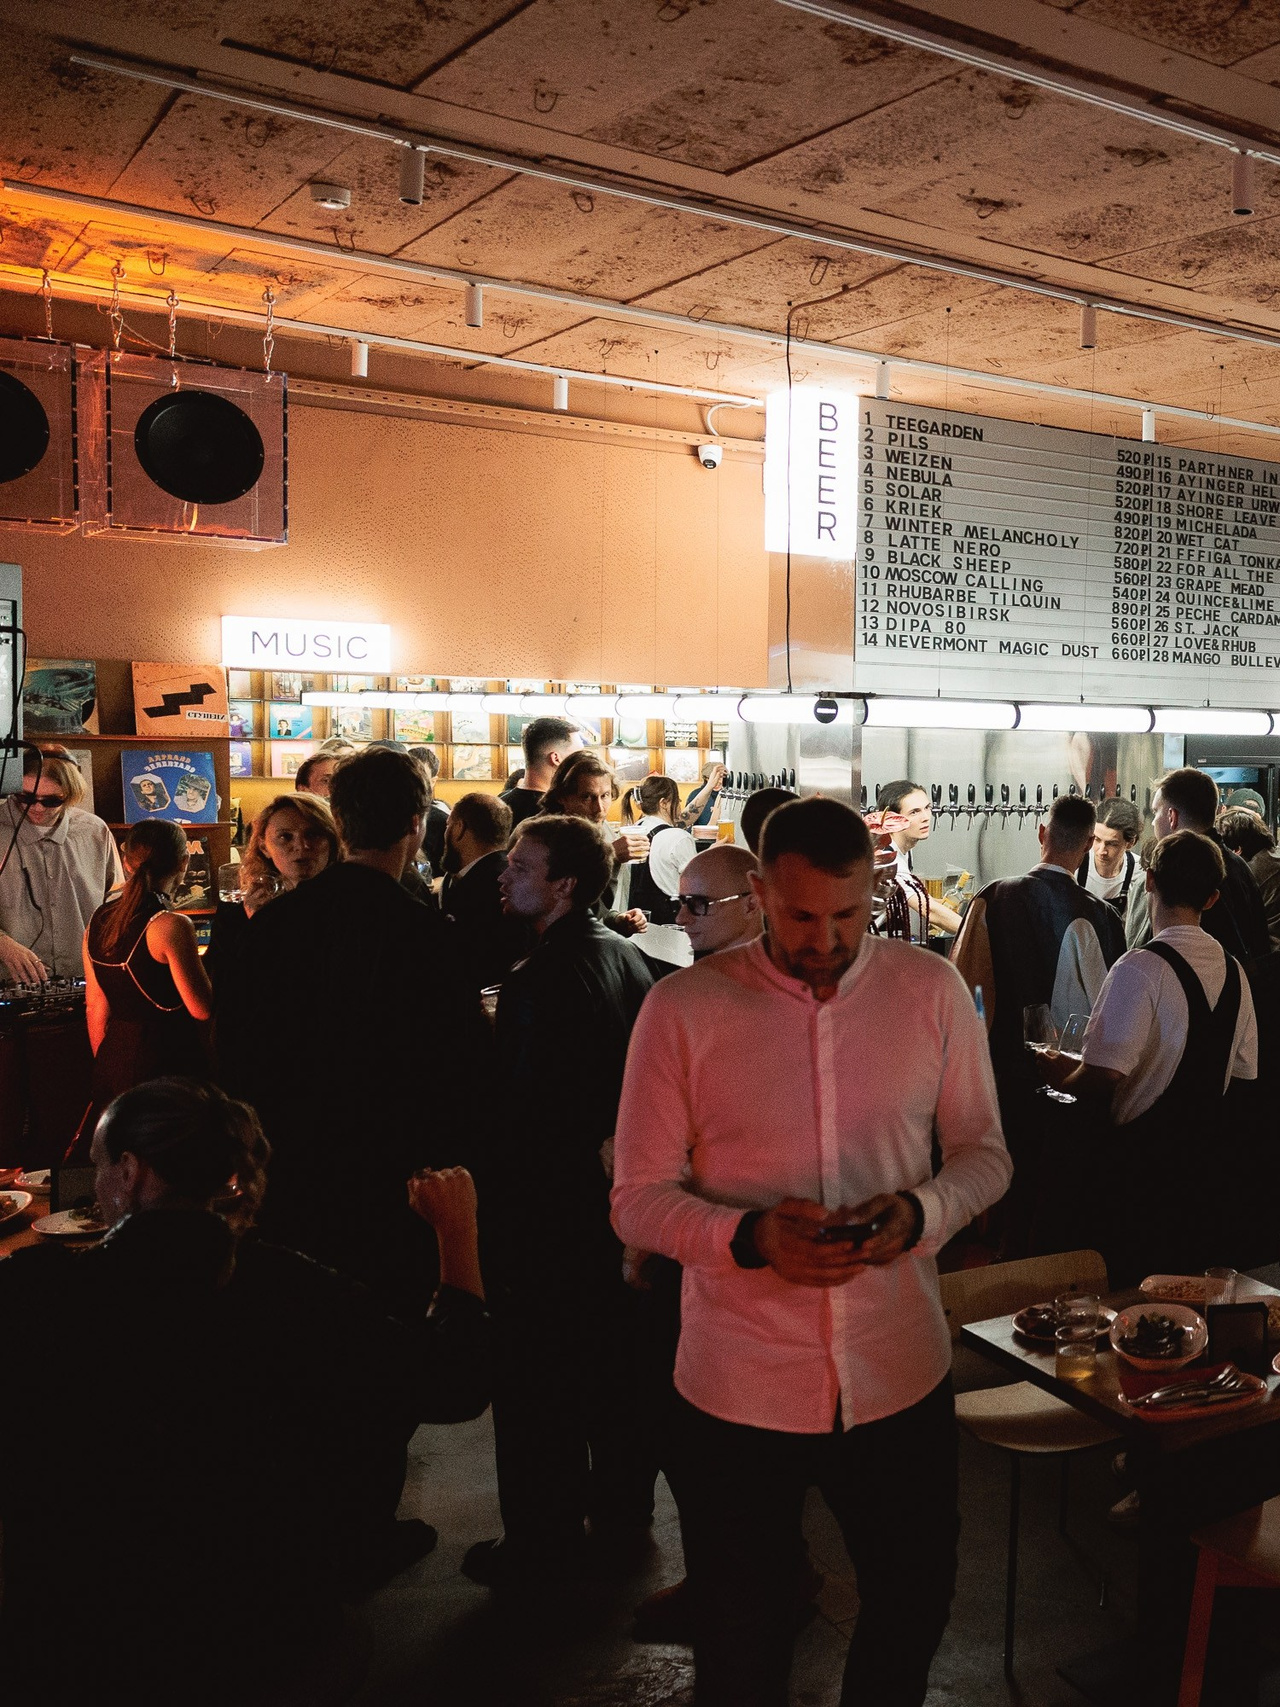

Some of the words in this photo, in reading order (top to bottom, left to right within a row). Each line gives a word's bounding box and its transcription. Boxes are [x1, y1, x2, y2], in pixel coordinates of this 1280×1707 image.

[864, 412, 872, 425] 1
[885, 414, 984, 441] TEEGARDEN
[864, 428, 874, 443] 2
[888, 432, 929, 450] PILS
[863, 445, 874, 460] 3
[885, 449, 952, 470] WEIZEN
[817, 402, 839, 541] BEER
[863, 463, 874, 477] 4
[886, 466, 953, 487] NEBULA
[1157, 456, 1172, 469] 15
[1178, 459, 1254, 482] PARTHNER
[1263, 469, 1278, 485] IN
[864, 480, 874, 494] 5
[885, 482, 942, 502] SOLAR
[1158, 471, 1172, 484] 16
[1177, 473, 1245, 495] AYINGER
[863, 497, 874, 511] 6
[885, 500, 942, 518] KRIEK
[1157, 486, 1171, 499] 17
[1177, 489, 1244, 509] AYINGER
[1156, 501, 1172, 514] 18
[1177, 504, 1224, 521] SHORE
[1234, 511, 1276, 527] LEAVE
[864, 514, 874, 528] 7
[885, 516, 953, 536] WINTER
[963, 525, 1080, 549] MELANCHOLY
[1156, 516, 1172, 529] 19
[1177, 518, 1258, 540] MICHELADA
[863, 530, 874, 544] 8
[888, 534, 941, 552] LATTE
[953, 540, 1001, 557] NERO
[1156, 531, 1173, 544] 20
[1176, 533, 1205, 548] WET
[1213, 537, 1240, 552] CAT
[1157, 546, 1171, 560] 21
[864, 547, 875, 562] 9
[888, 550, 941, 568] BLACK
[953, 556, 1011, 574] SHEEP
[862, 565, 880, 580] 10
[885, 567, 958, 586] MOSCOW
[965, 574, 1044, 592] CALLING
[1156, 561, 1172, 574] 22
[1177, 563, 1205, 577] FOR
[1213, 567, 1240, 581] ALL
[1247, 570, 1274, 584] THE
[862, 582, 877, 596] 11
[887, 583, 977, 603] RHUBARBE
[990, 591, 1061, 610] TILQUIN
[1155, 591, 1171, 604] 24
[1156, 576, 1172, 589] 23
[1176, 577, 1222, 593] GRAPE
[1231, 582, 1265, 597] MEAD
[862, 599, 879, 613] 12
[886, 600, 1010, 622] NOVOSIBIRSK
[1155, 605, 1171, 619] 25
[1176, 607, 1221, 623] PECHE
[861, 616, 879, 630] 13
[886, 617, 931, 633] DIPA
[945, 621, 966, 635] 80
[1154, 620, 1169, 633] 26
[1203, 623, 1240, 638] JACK
[252, 631, 367, 659] MUSIC
[862, 632, 878, 646] 14
[885, 634, 988, 653] NEVERMONT
[999, 640, 1049, 656] MAGIC
[1061, 644, 1099, 659] DUST
[1153, 636, 1168, 648] 27
[1152, 650, 1169, 663] 28
[1172, 652, 1221, 666] MANGO
